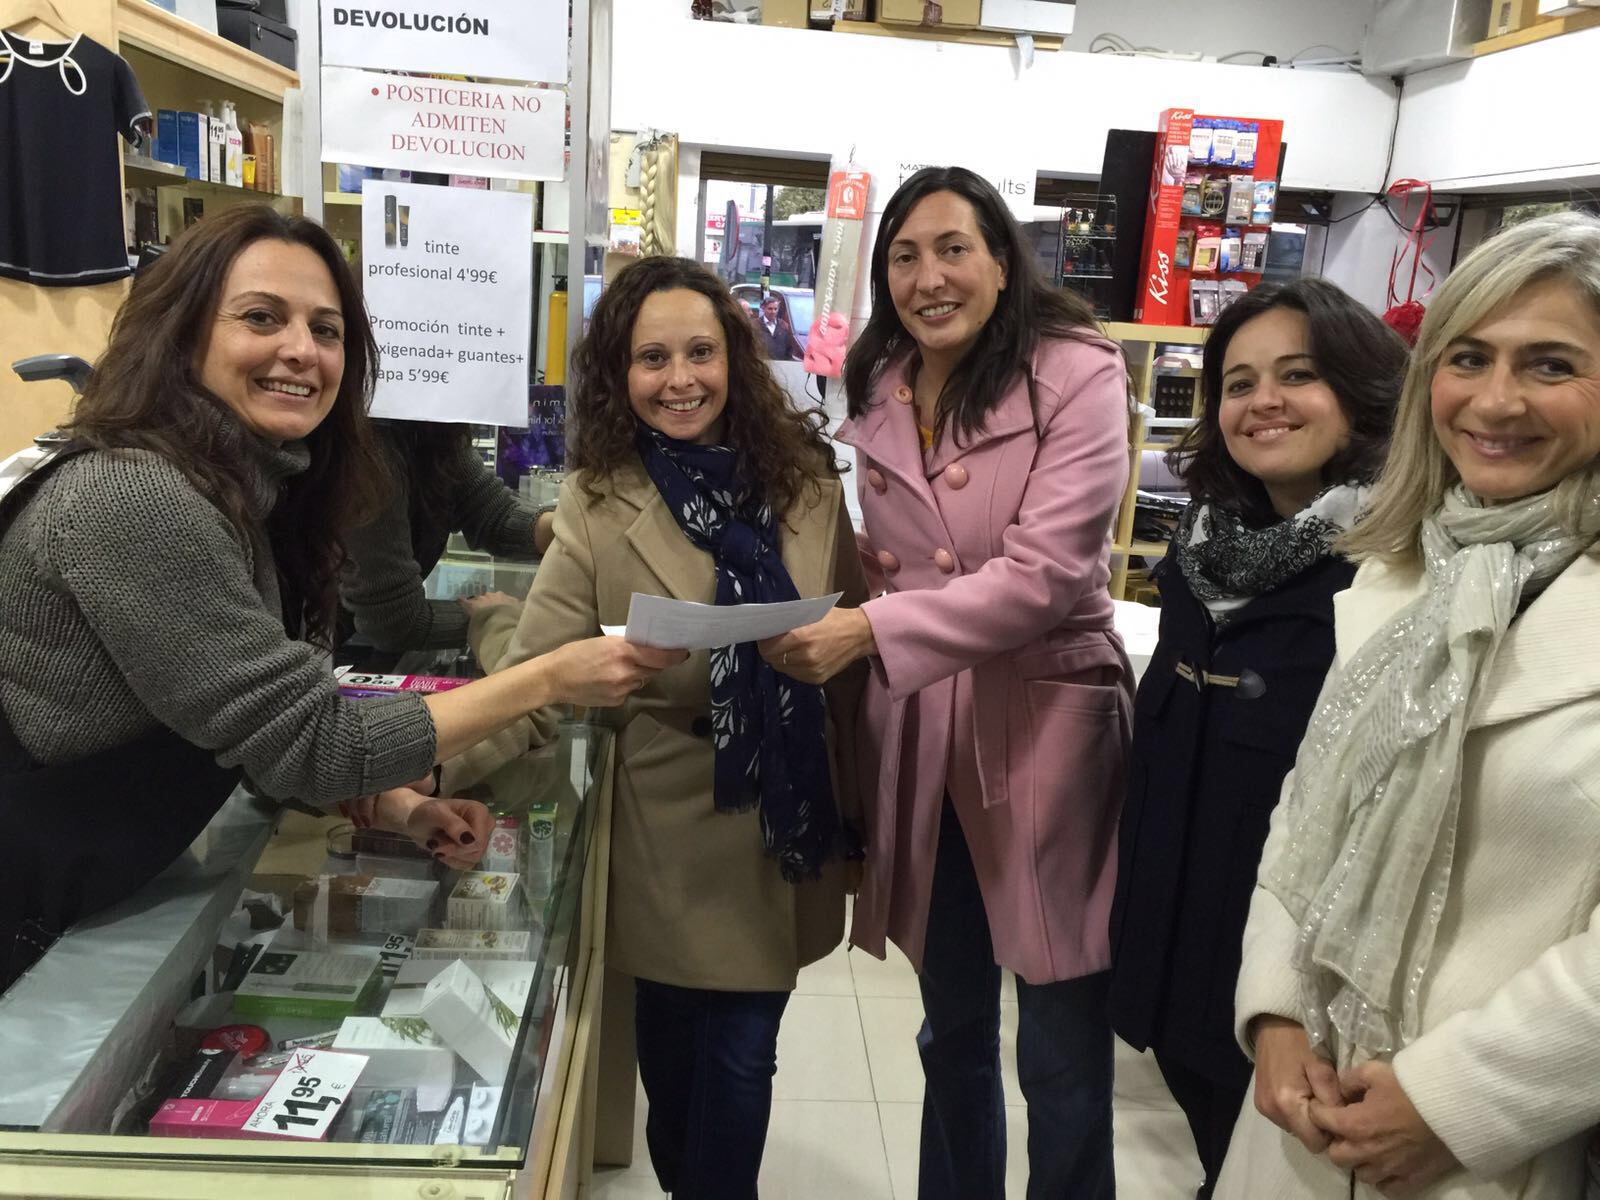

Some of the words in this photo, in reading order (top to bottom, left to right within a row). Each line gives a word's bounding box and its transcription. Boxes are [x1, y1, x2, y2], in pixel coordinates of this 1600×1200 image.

[333, 8, 489, 36] DEVOLUCIÓN
[386, 84, 505, 110] POSTICERIA
[512, 96, 541, 113] NO
[411, 112, 506, 134] ADMITEN
[1170, 111, 1193, 120] Kiss
[392, 134, 526, 161] DEVOLUCION
[424, 240, 460, 255] tinte
[368, 263, 452, 281] profesional
[456, 268, 498, 284] 4'99€
[1149, 249, 1170, 305] Kiss
[369, 315, 449, 334] Promoción
[458, 322, 492, 337] tinte
[497, 328, 505, 336] +
[376, 342, 454, 360] xigenada+
[458, 350, 524, 364] guantes+
[377, 368, 403, 382] apa
[249, 1101, 275, 1128] AHORA
